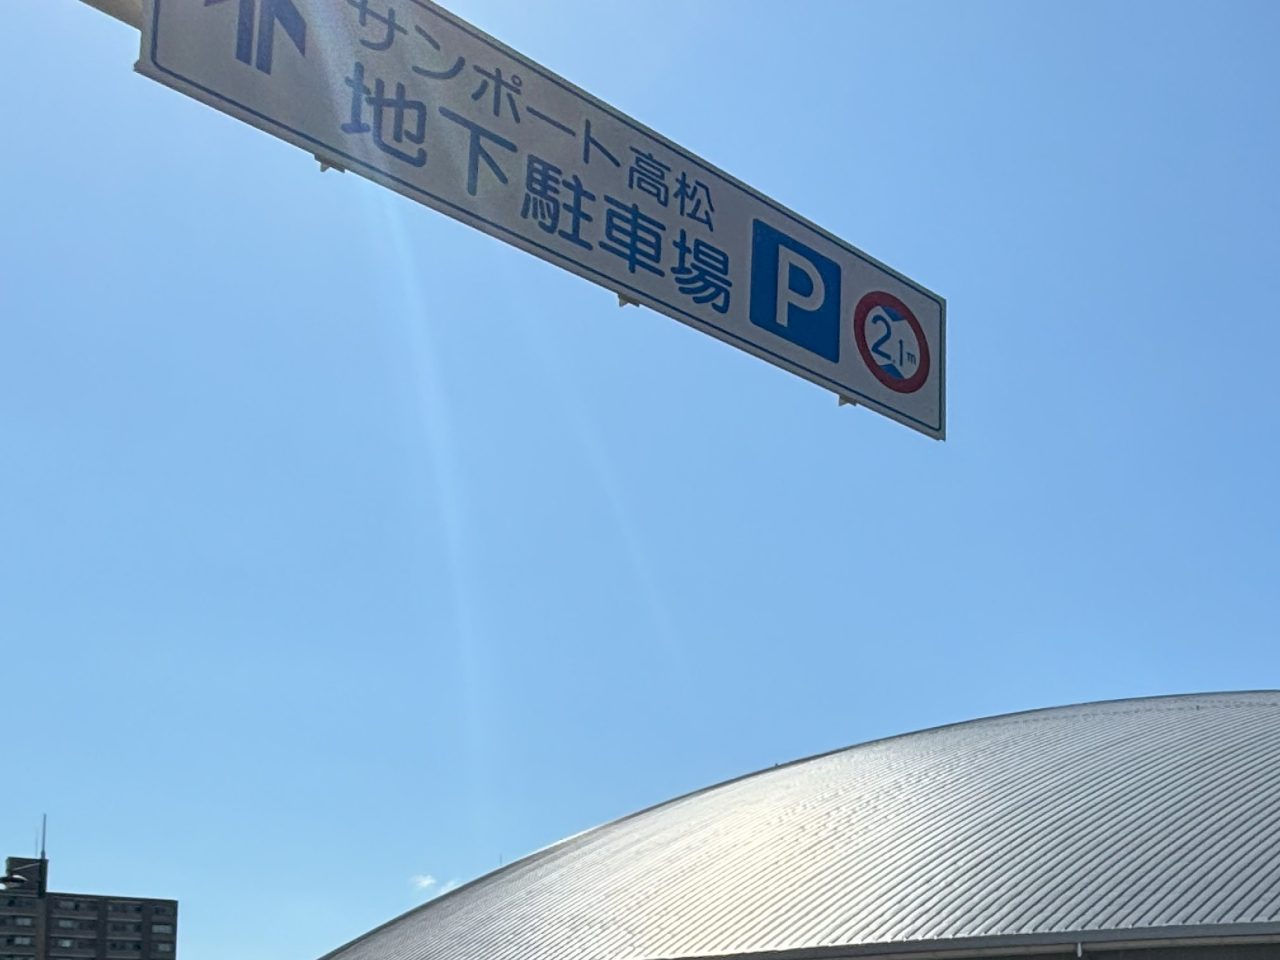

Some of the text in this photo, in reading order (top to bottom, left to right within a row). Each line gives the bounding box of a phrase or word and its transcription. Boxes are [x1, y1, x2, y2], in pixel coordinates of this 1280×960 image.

[341, 62, 733, 314] 地下駐車場
[346, 0, 714, 232] サンポート高松
[775, 243, 826, 328] P
